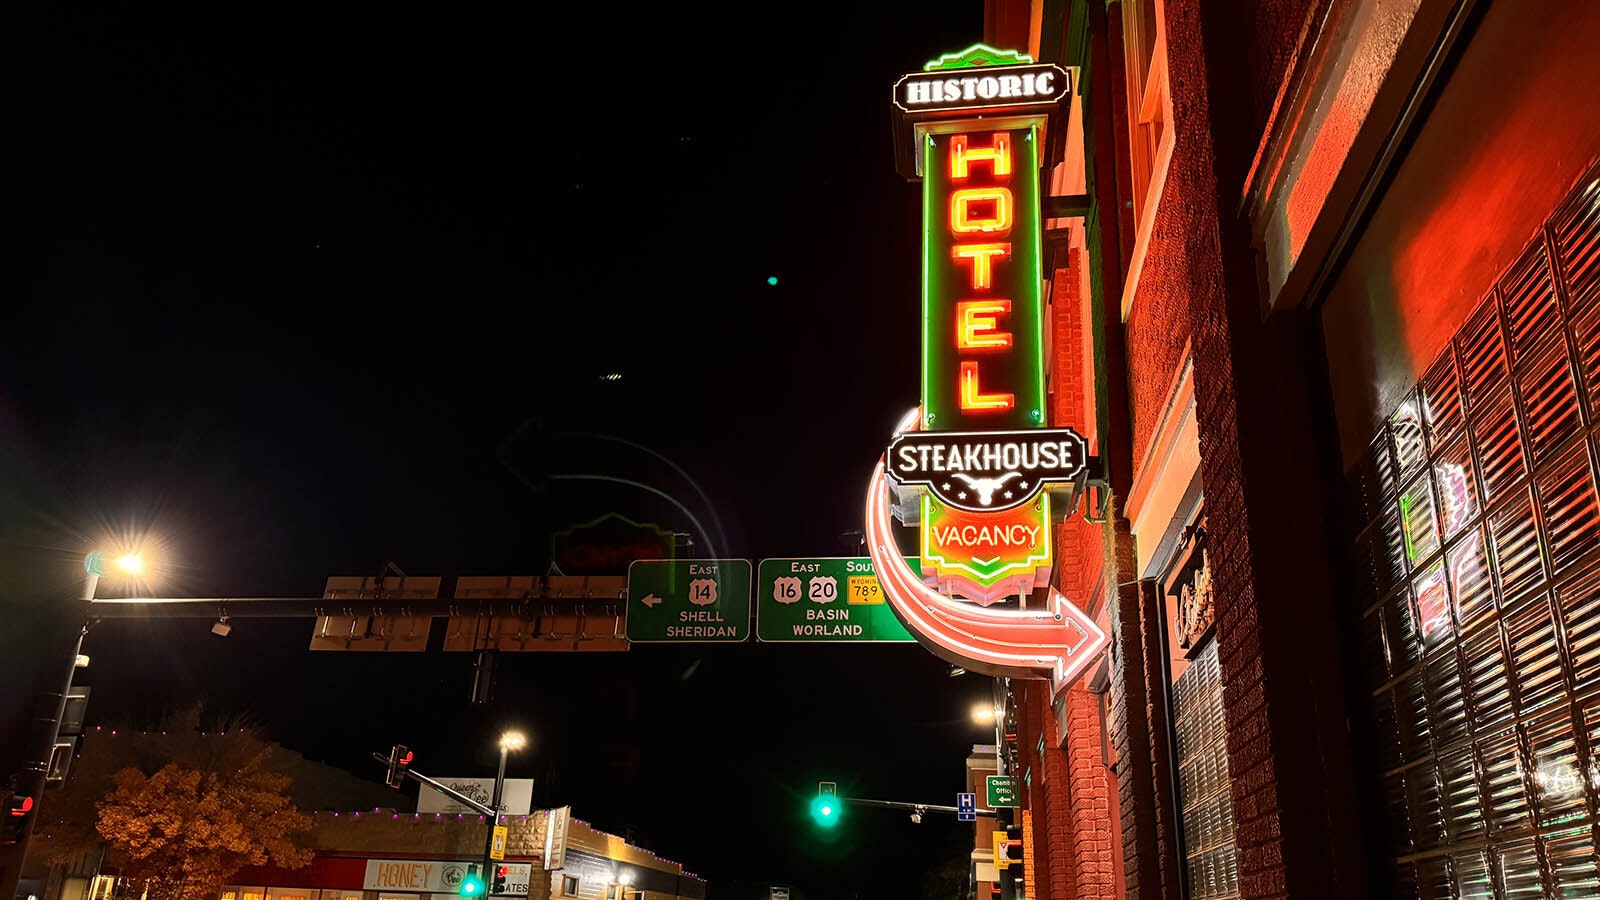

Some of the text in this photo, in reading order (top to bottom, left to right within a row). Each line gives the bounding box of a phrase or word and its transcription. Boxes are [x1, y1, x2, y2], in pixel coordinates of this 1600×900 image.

[906, 72, 1055, 104] HISTORIC
[950, 132, 1014, 409] HOTEL
[899, 441, 1073, 471] STEAKHOUSE
[932, 525, 1040, 546] VACANCY
[689, 564, 718, 575] EAST
[791, 561, 876, 573] EAST SOUT
[694, 584, 710, 600] 14
[780, 582, 834, 598] 16 20
[854, 586, 878, 596] 789
[679, 610, 724, 622] SHELL
[806, 609, 849, 621] BASIN
[666, 626, 737, 637] SHERIDAN
[792, 625, 863, 637] WORLAND
[961, 793, 972, 807] H
[377, 862, 433, 889] HONEY
